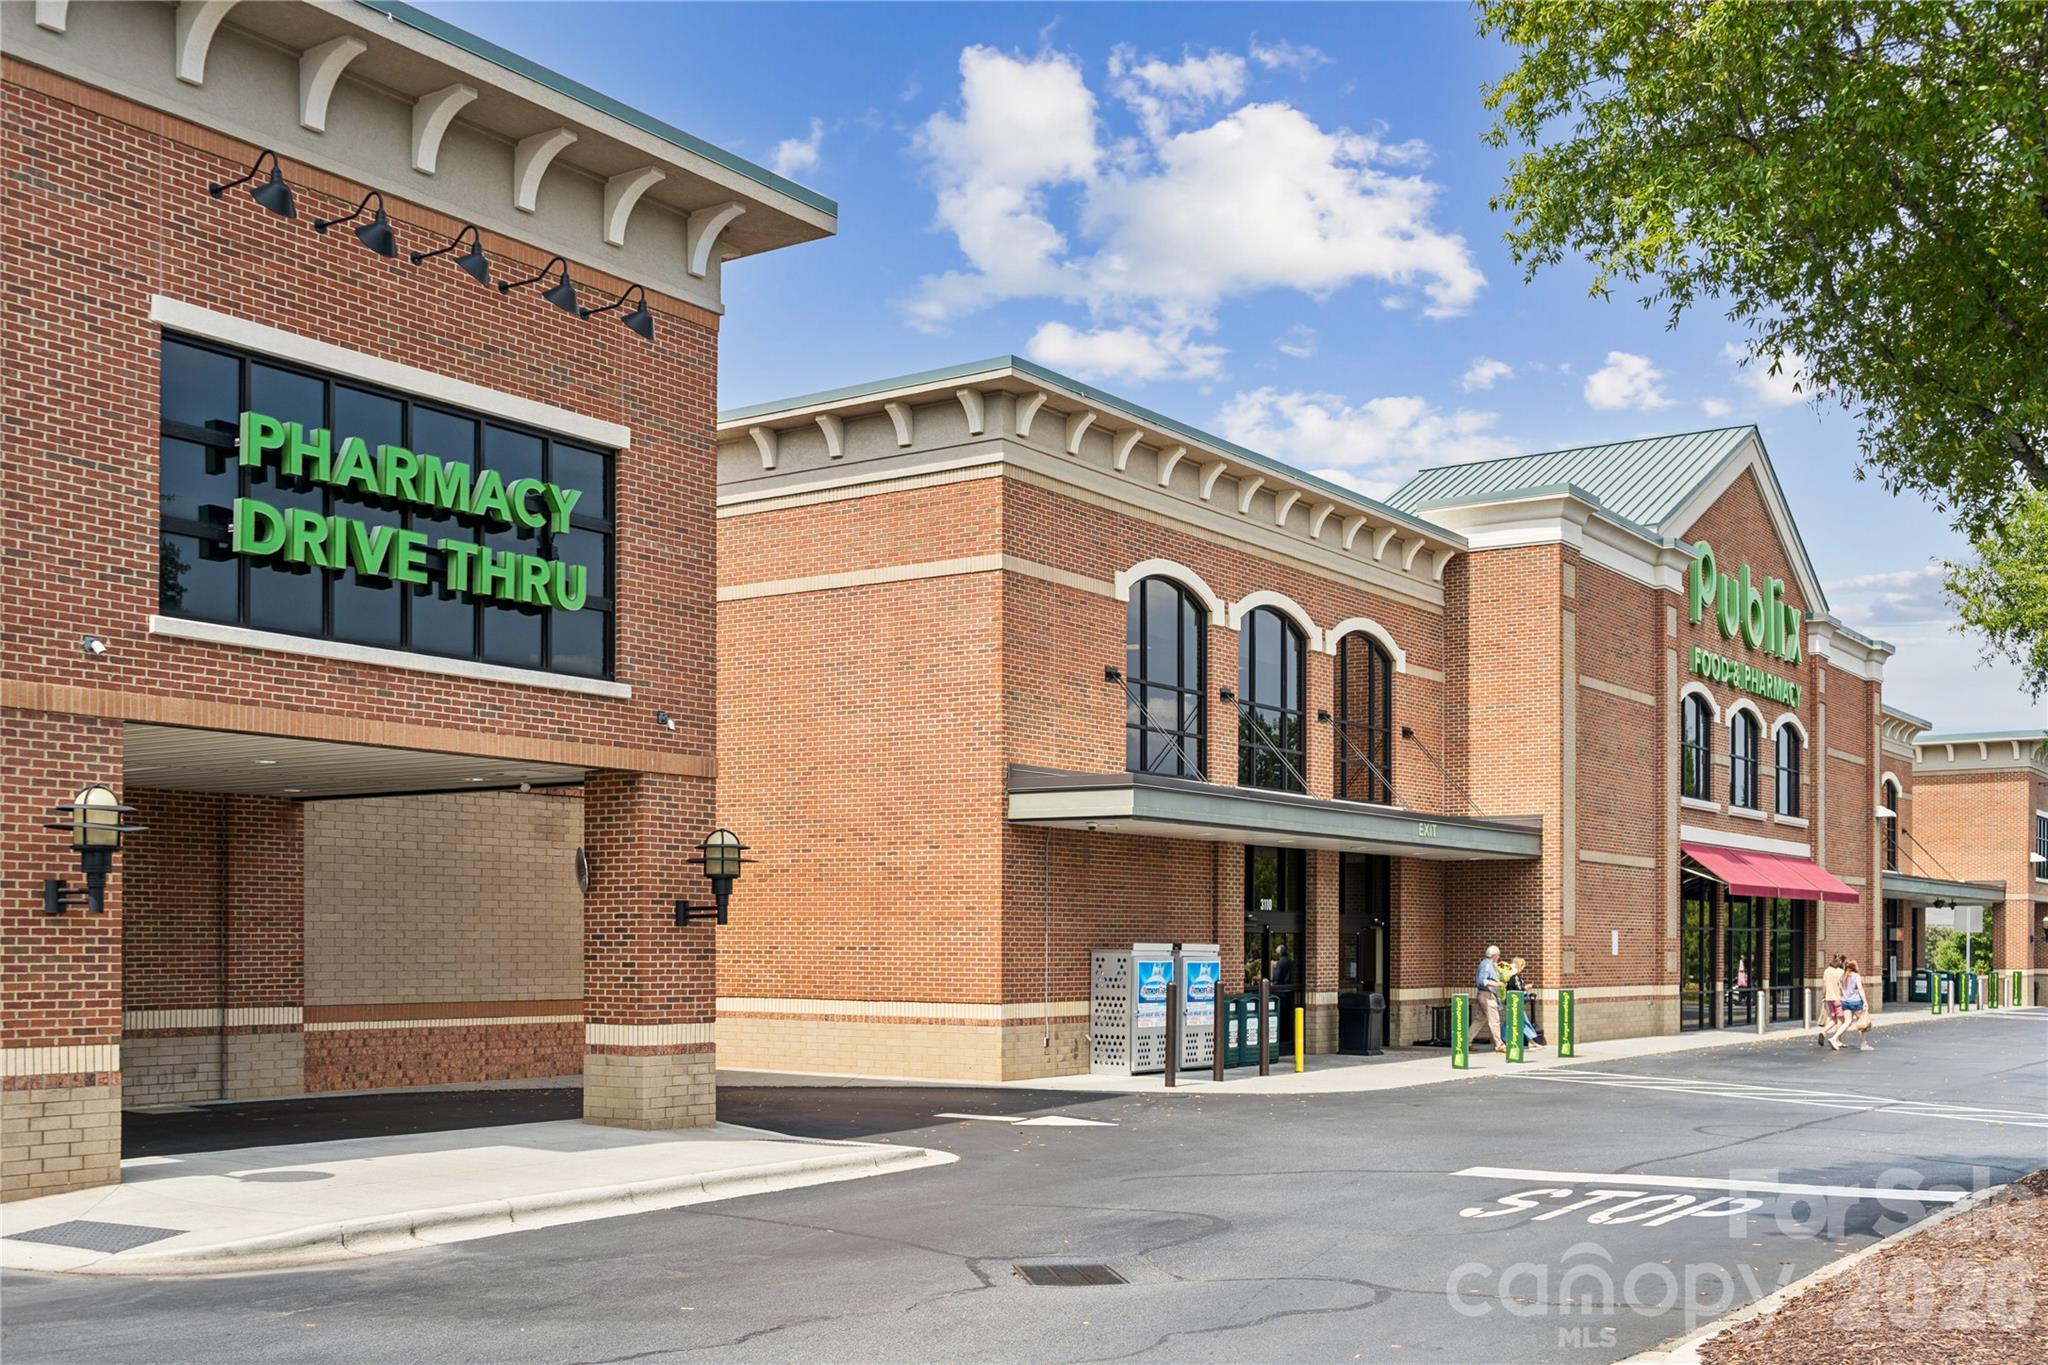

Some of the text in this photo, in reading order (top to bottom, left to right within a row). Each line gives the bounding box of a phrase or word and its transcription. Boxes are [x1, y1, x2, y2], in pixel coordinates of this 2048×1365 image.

[239, 411, 583, 534] PHARMACY
[232, 498, 588, 612] DRIVE THRU
[1689, 540, 1802, 665] Publix
[1688, 645, 1802, 708] FOOD & PHARMACY
[1418, 822, 1437, 837] EXIT
[1459, 1188, 1764, 1227] STOP
